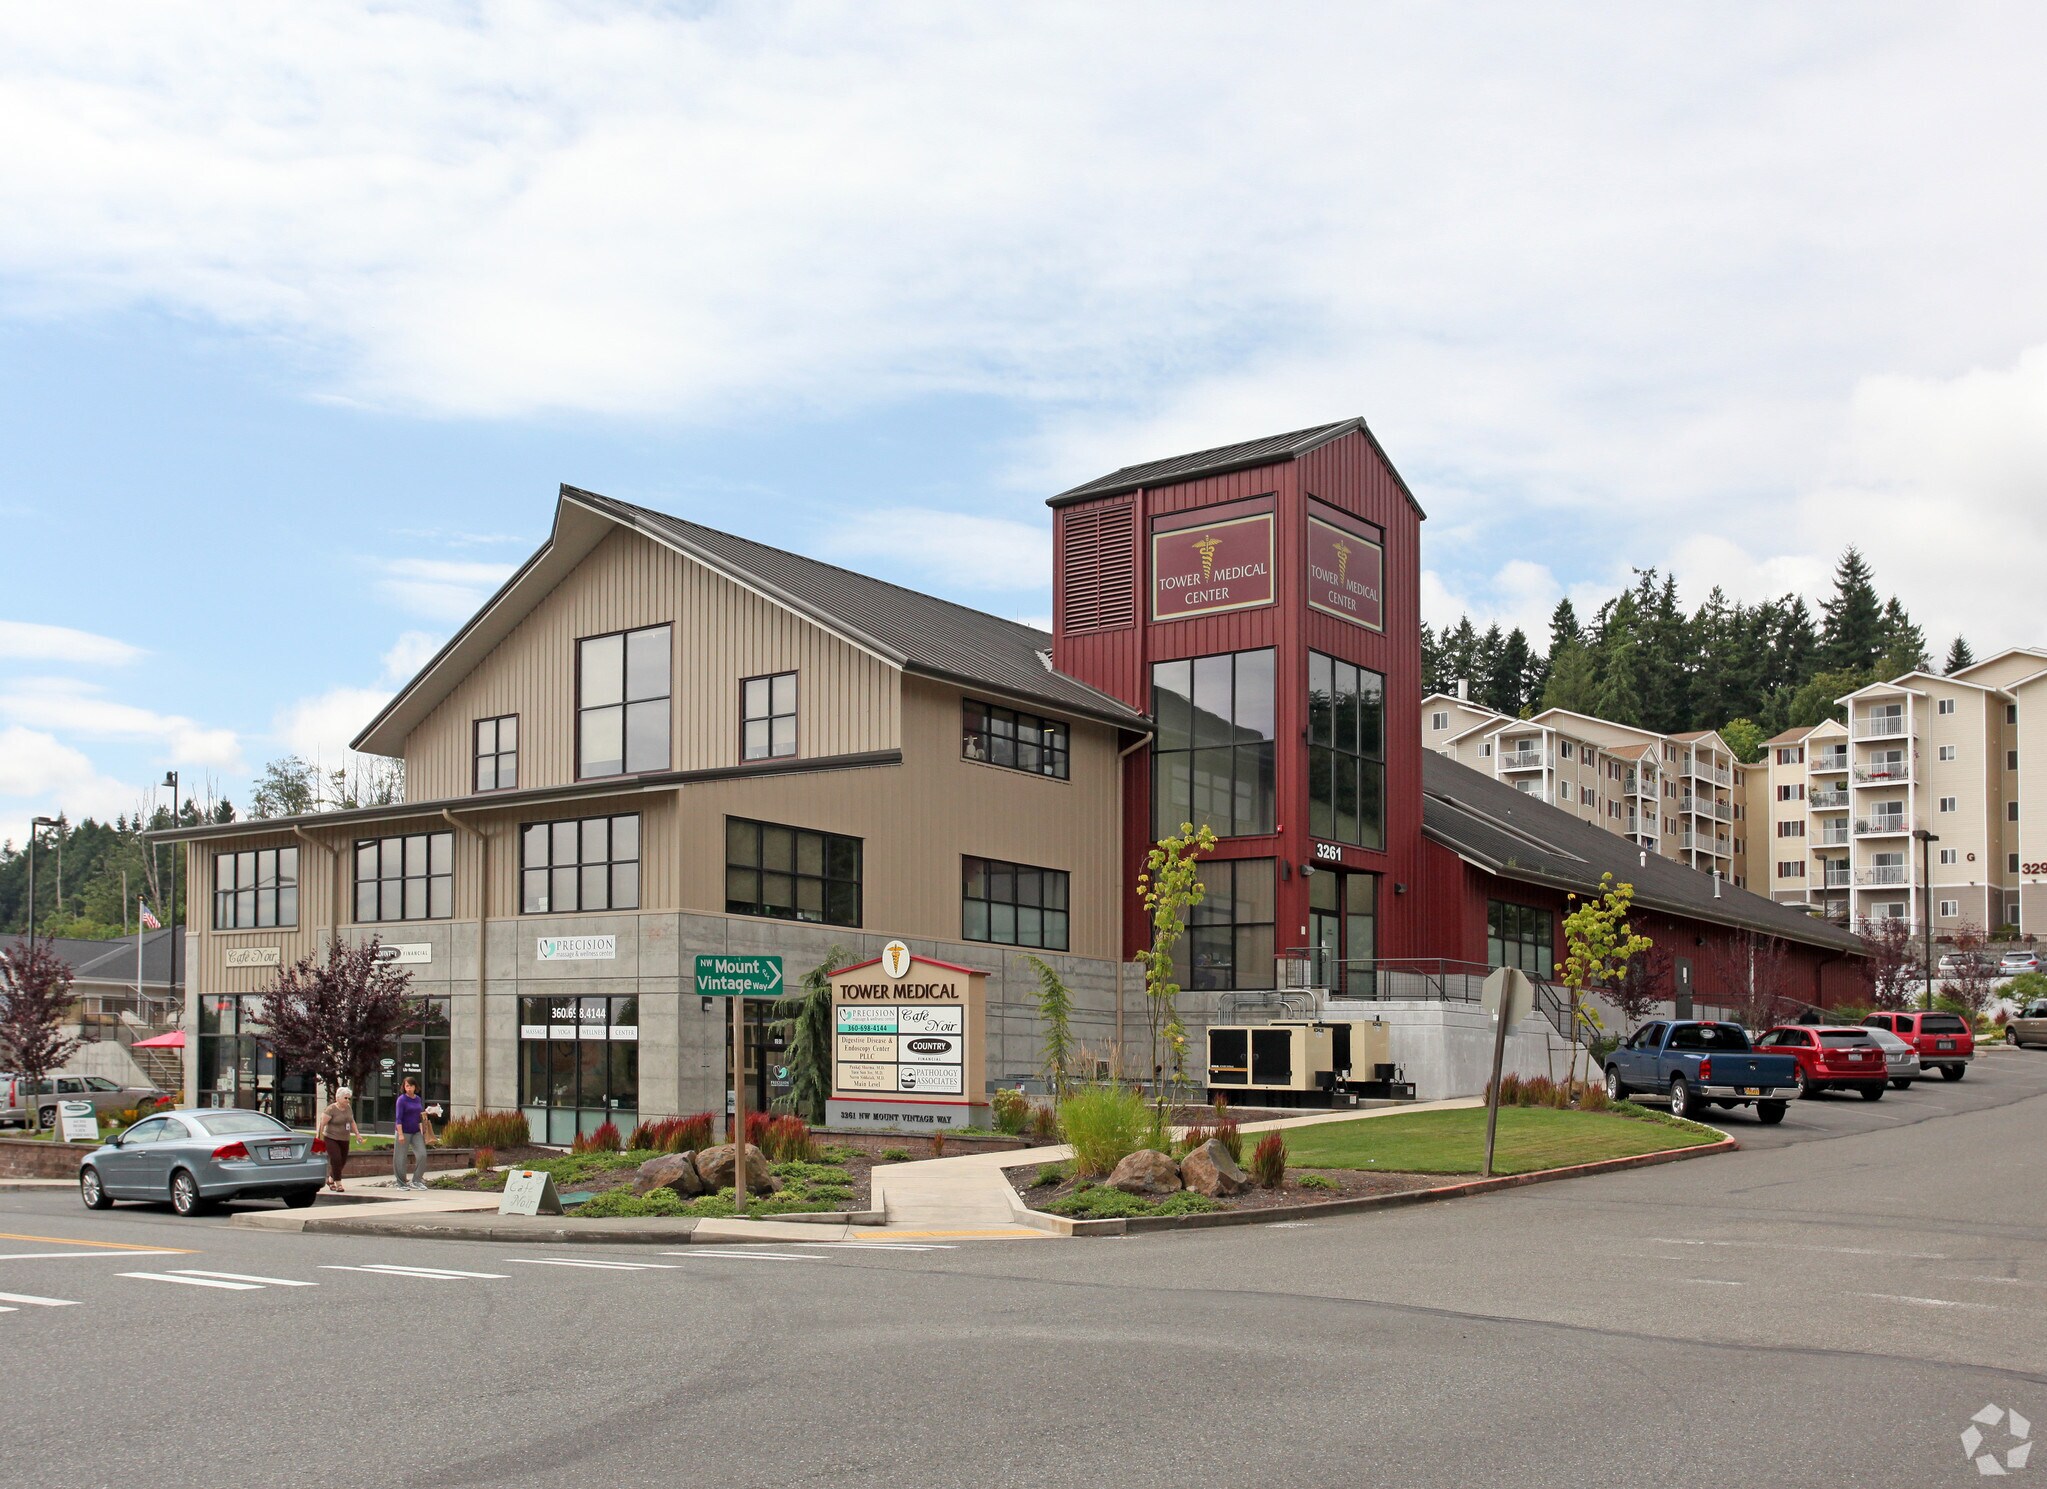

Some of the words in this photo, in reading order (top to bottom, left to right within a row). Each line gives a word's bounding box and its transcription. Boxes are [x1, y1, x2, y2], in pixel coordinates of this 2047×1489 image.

[1159, 573, 1201, 590] TOWER
[1213, 562, 1267, 582] MEDICAL
[1311, 564, 1339, 586] TOWER
[1346, 579, 1378, 602] MEDICAL
[1185, 587, 1230, 605] CENTER
[1328, 590, 1357, 611] CENTER
[1316, 843, 1341, 861] 3261
[1966, 853, 1975, 861] G
[557, 939, 613, 950] PRECISION
[251, 949, 277, 962] Noir
[700, 959, 713, 967] NW
[715, 959, 759, 974] Mount
[697, 975, 752, 994] Vintage
[752, 982, 768, 991] Way
[840, 984, 890, 999] TOWER
[893, 984, 959, 999] MEDICAL
[853, 1009, 895, 1017] PRECISION
[848, 1024, 887, 1032] 360-698-4144
[925, 1019, 957, 1032] Noir
[841, 1036, 865, 1044] Digestive
[912, 1042, 946, 1050] COUNTRY
[844, 1045, 870, 1053] Endoscopy
[917, 1069, 958, 1077] PATHOLOGY
[917, 1077, 958, 1085] ASSOCIATES
[858, 1112, 871, 1120] NW
[873, 1113, 899, 1121] MOUNT
[902, 1114, 934, 1123] VINTAGE
[936, 1115, 952, 1124] WAY
